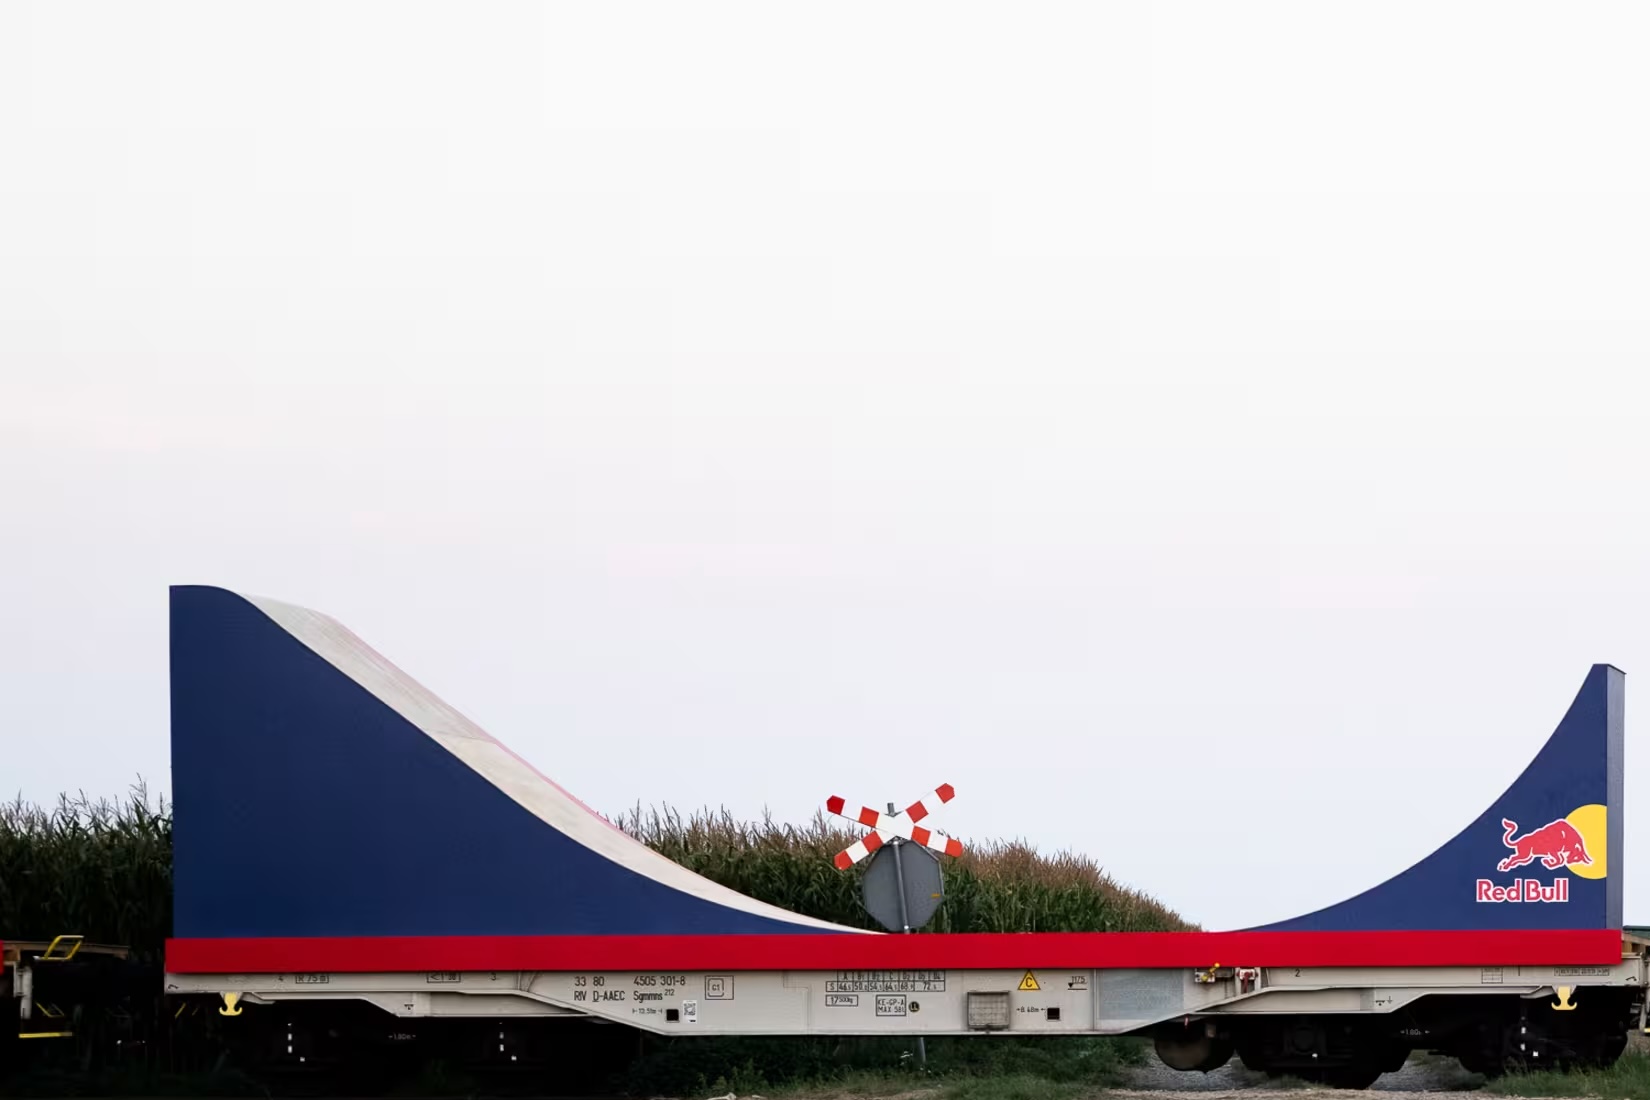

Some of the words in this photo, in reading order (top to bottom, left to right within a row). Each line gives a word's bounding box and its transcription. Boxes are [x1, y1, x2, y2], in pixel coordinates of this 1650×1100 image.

[1477, 878, 1522, 902] Red
[1524, 878, 1569, 902] Bull
[574, 976, 586, 987] 33
[593, 976, 605, 987] 80
[633, 976, 657, 986] 4505
[660, 975, 686, 986] 301-8
[1025, 976, 1033, 988] C
[574, 991, 587, 1001] RIV
[592, 991, 625, 1002] D-AAEC
